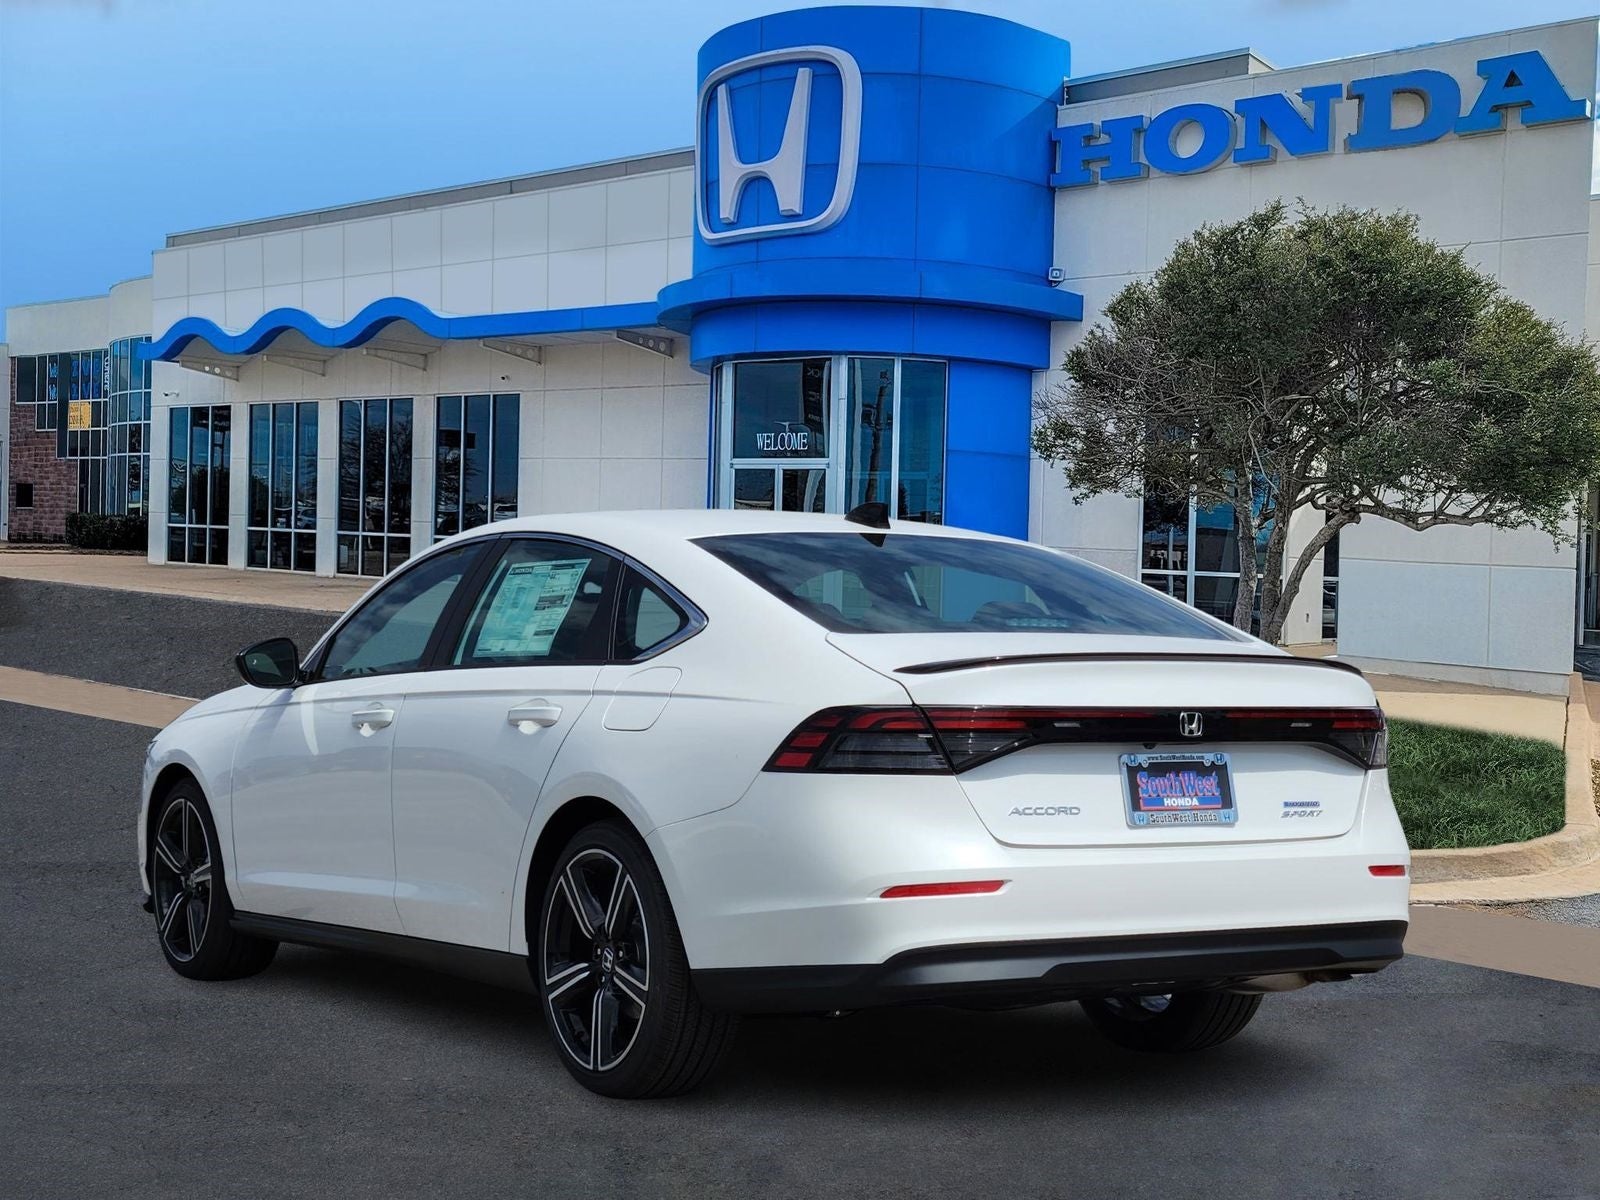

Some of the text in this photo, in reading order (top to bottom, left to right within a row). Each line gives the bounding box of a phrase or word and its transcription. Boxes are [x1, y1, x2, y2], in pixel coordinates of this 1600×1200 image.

[1051, 49, 1592, 187] HONDA
[756, 432, 808, 451] WELCOME
[1137, 771, 1221, 797] SouthWest
[1164, 797, 1199, 806] HONDA
[1008, 806, 1081, 816] ACCORD
[1150, 812, 1218, 824] SouthWest Honda
